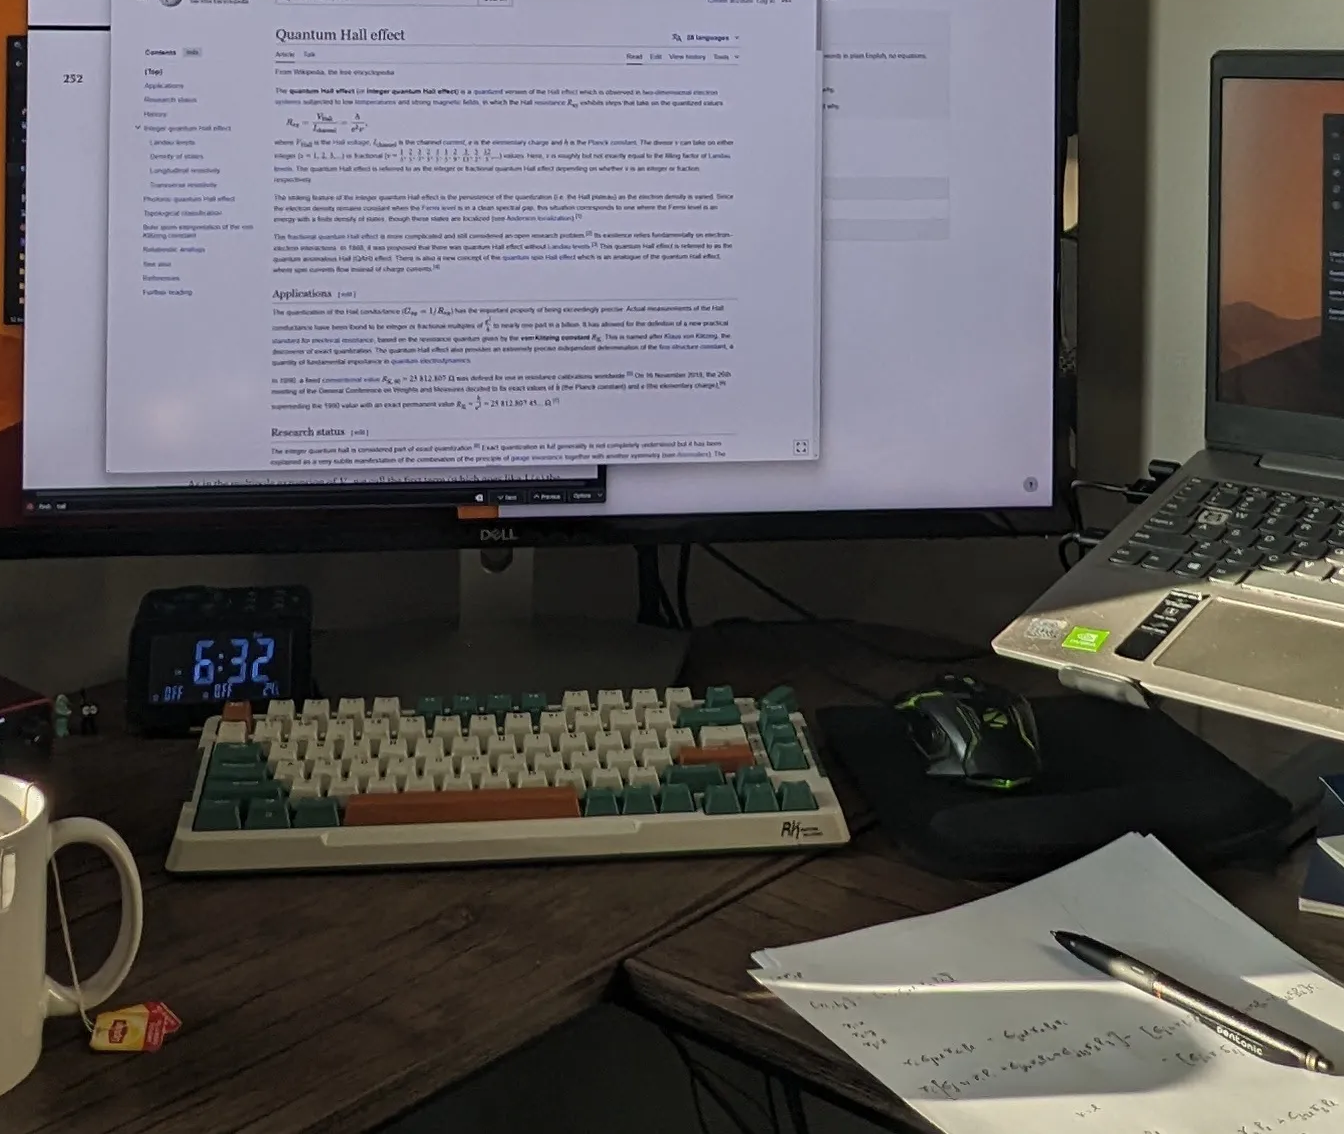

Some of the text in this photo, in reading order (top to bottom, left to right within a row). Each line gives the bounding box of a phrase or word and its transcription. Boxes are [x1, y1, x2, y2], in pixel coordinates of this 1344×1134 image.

[275, 27, 406, 42] Quantum Hall effect
[697, 34, 729, 43] languages
[626, 53, 643, 61] Read
[669, 53, 685, 61] View
[62, 72, 85, 86] 252
[290, 88, 319, 96] quantum
[272, 289, 332, 300] Applications
[271, 427, 345, 438] Research status
[480, 529, 518, 541] DELL
[193, 637, 275, 685] 6:32
[164, 685, 184, 702] OFF
[214, 683, 233, 698] OFF
